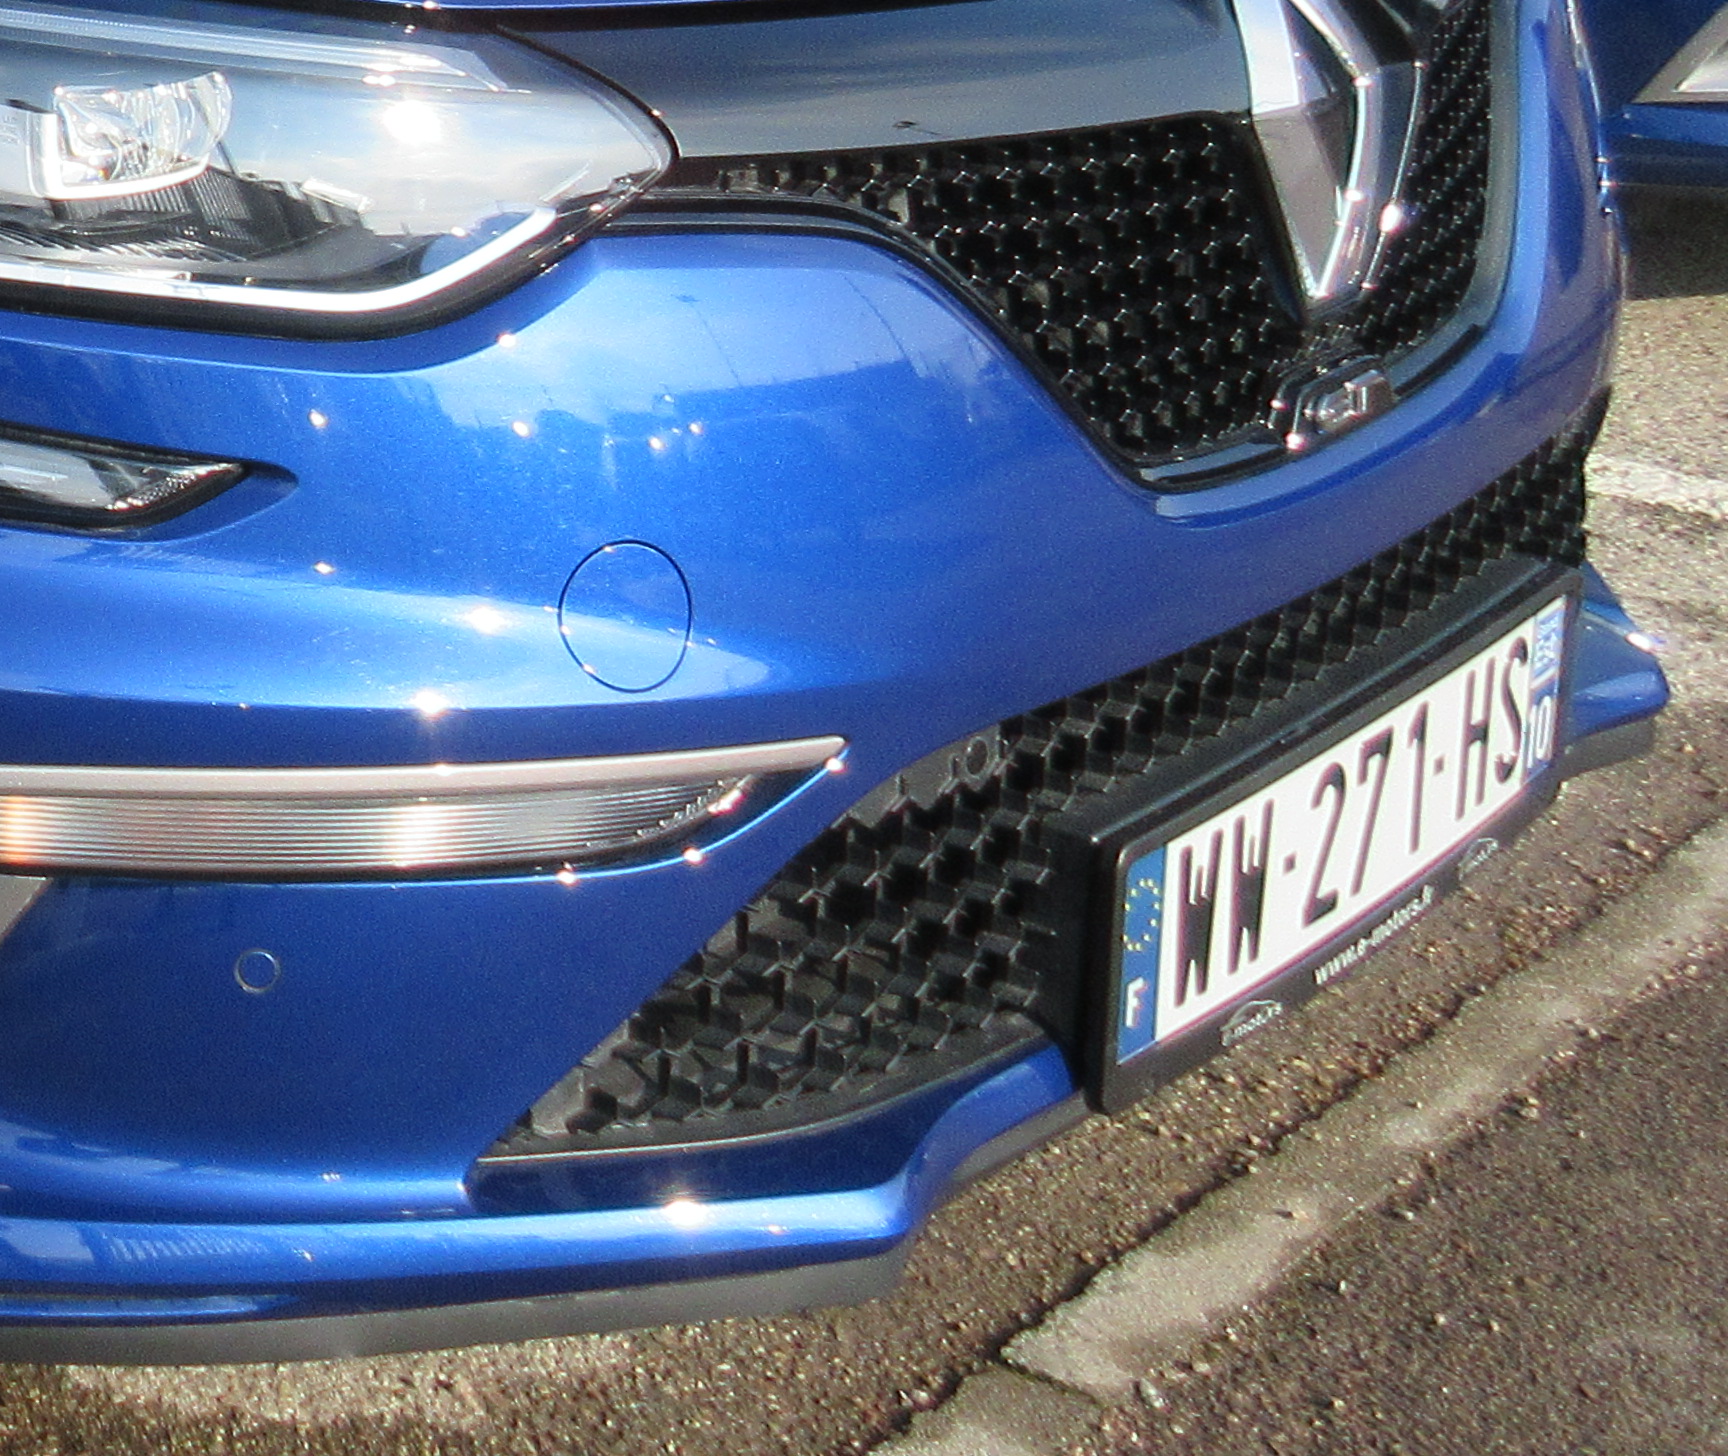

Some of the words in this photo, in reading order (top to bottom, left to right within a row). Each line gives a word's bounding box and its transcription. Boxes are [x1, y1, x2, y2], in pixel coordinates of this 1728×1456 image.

[1126, 978, 1148, 1030] F
[1174, 636, 1529, 1008] WW-271-HS
[1526, 695, 1553, 769] 10
